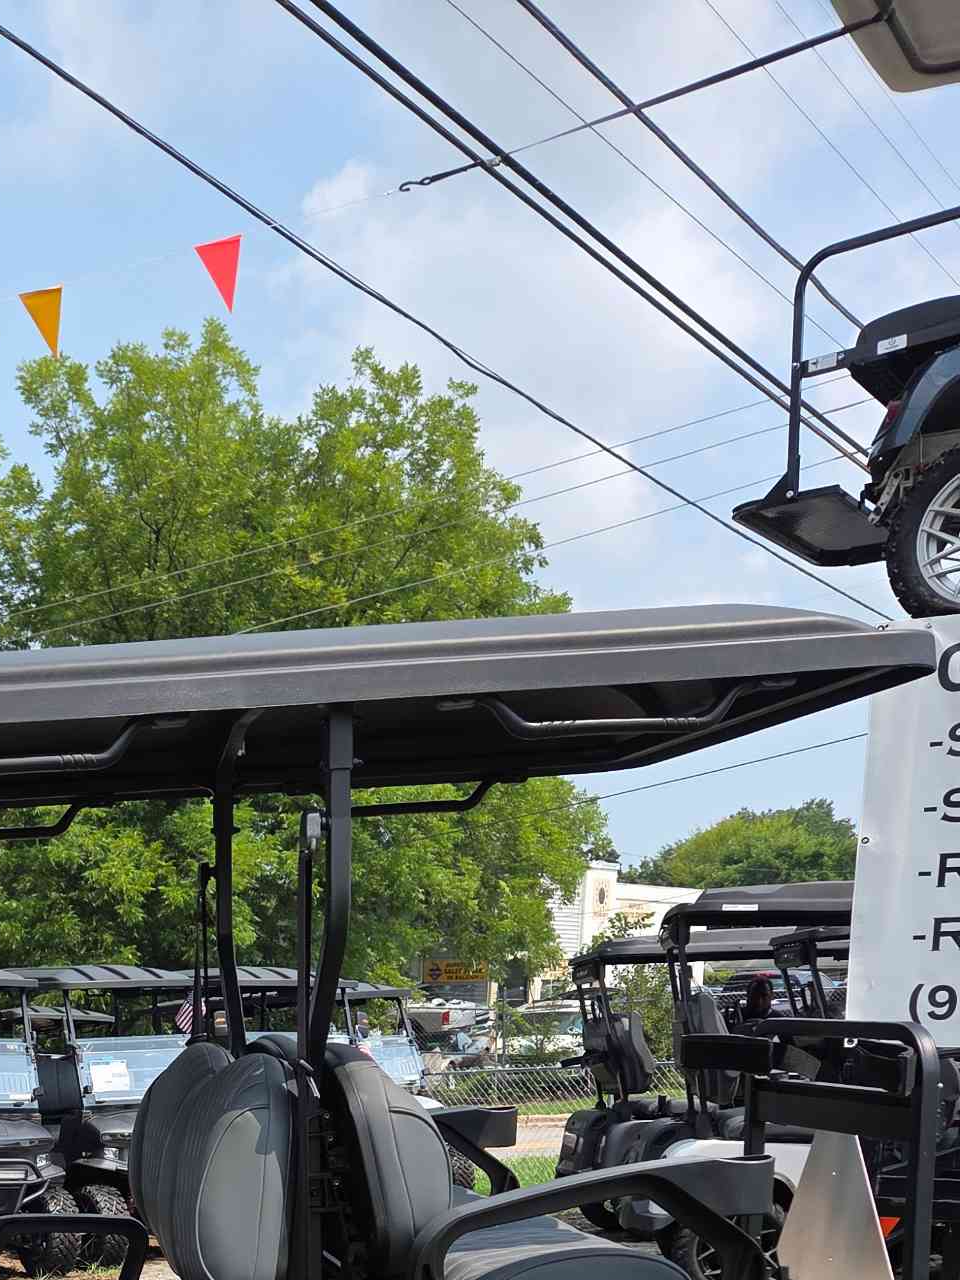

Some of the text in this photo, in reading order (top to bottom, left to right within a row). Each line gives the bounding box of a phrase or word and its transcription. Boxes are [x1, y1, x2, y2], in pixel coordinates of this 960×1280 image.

[918, 853, 960, 887] -R
[913, 917, 960, 951] -R
[909, 984, 958, 1025] (9
